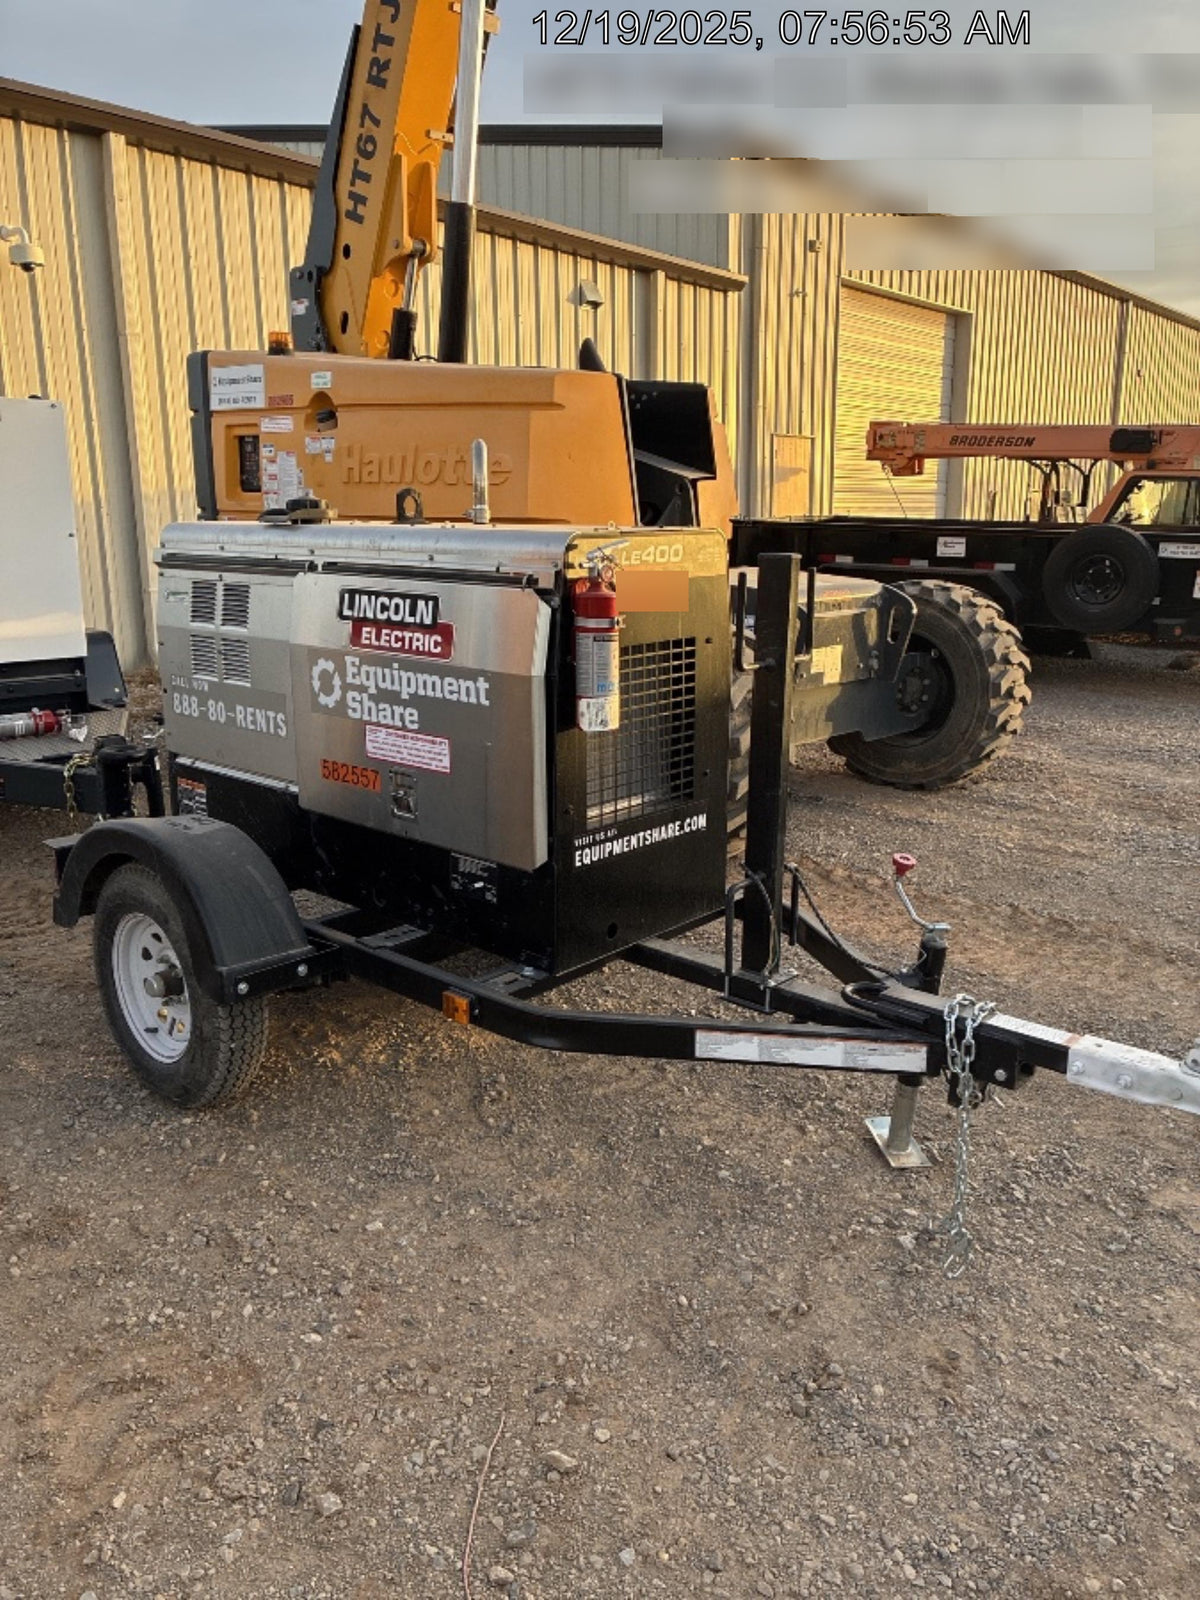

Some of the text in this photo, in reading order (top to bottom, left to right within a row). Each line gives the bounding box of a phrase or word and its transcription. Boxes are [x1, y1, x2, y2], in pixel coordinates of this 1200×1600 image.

[345, 0, 401, 225] HT67 RTJ
[949, 435, 1036, 447] BRODERSON
[621, 543, 684, 565] LE400
[342, 593, 434, 625] LINCOLN
[361, 627, 442, 653] ELECTRIC
[344, 655, 490, 706] Equipment
[173, 692, 288, 737] 888-80-RENTS
[346, 690, 420, 730] Share
[321, 758, 380, 790] 582557
[575, 813, 707, 867] EQUIPMENTSHARE.COM
